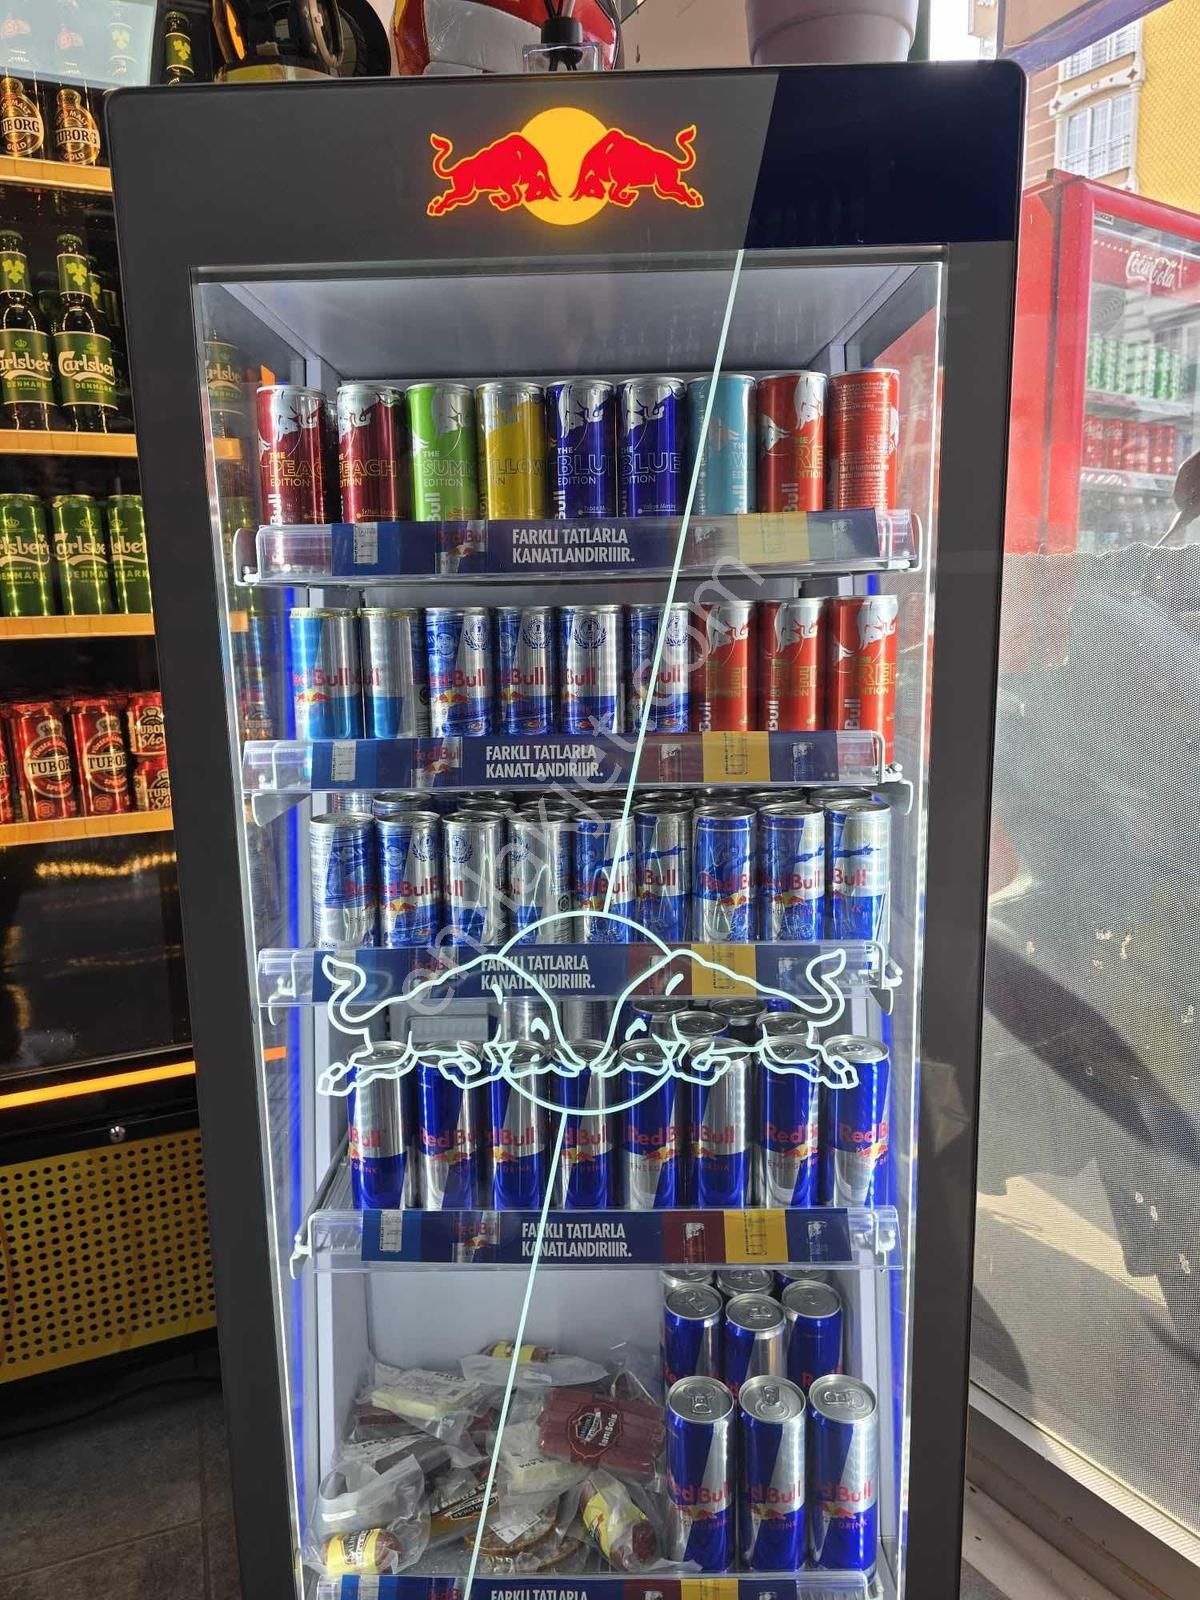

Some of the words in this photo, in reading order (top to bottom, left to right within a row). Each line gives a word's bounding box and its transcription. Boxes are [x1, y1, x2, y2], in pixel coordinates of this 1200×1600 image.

[269, 459, 322, 478] PEAC
[339, 459, 398, 478] EACH
[512, 528, 558, 544] FARKLI
[562, 528, 628, 544] TATLARLA
[512, 548, 635, 564] KANATLANDIRIIIR.
[314, 667, 351, 687] Bull
[453, 667, 486, 688] Bull
[511, 666, 545, 686] Bull
[563, 667, 597, 687] Bull
[767, 700, 779, 732] Bull
[844, 698, 861, 731] Bull
[486, 745, 530, 762] FARKLI
[533, 744, 596, 761] TATLARLA
[486, 762, 604, 780] KANATLANDIRIIIR.
[643, 869, 677, 887] Bull
[790, 870, 821, 890] Bull
[832, 868, 867, 887] Bull
[481, 955, 525, 972] FARKLI
[528, 955, 589, 971] TATLARLA
[502, 1126, 536, 1146] Bull
[627, 1124, 664, 1146] Red
[702, 1125, 736, 1145] Bull
[764, 1122, 804, 1144] Red
[840, 1122, 877, 1143] Red
[566, 1223, 626, 1239] TATLARLA
[700, 1480, 732, 1504] Bull
[767, 1480, 801, 1504] Bull
[835, 1480, 874, 1503] Bull
